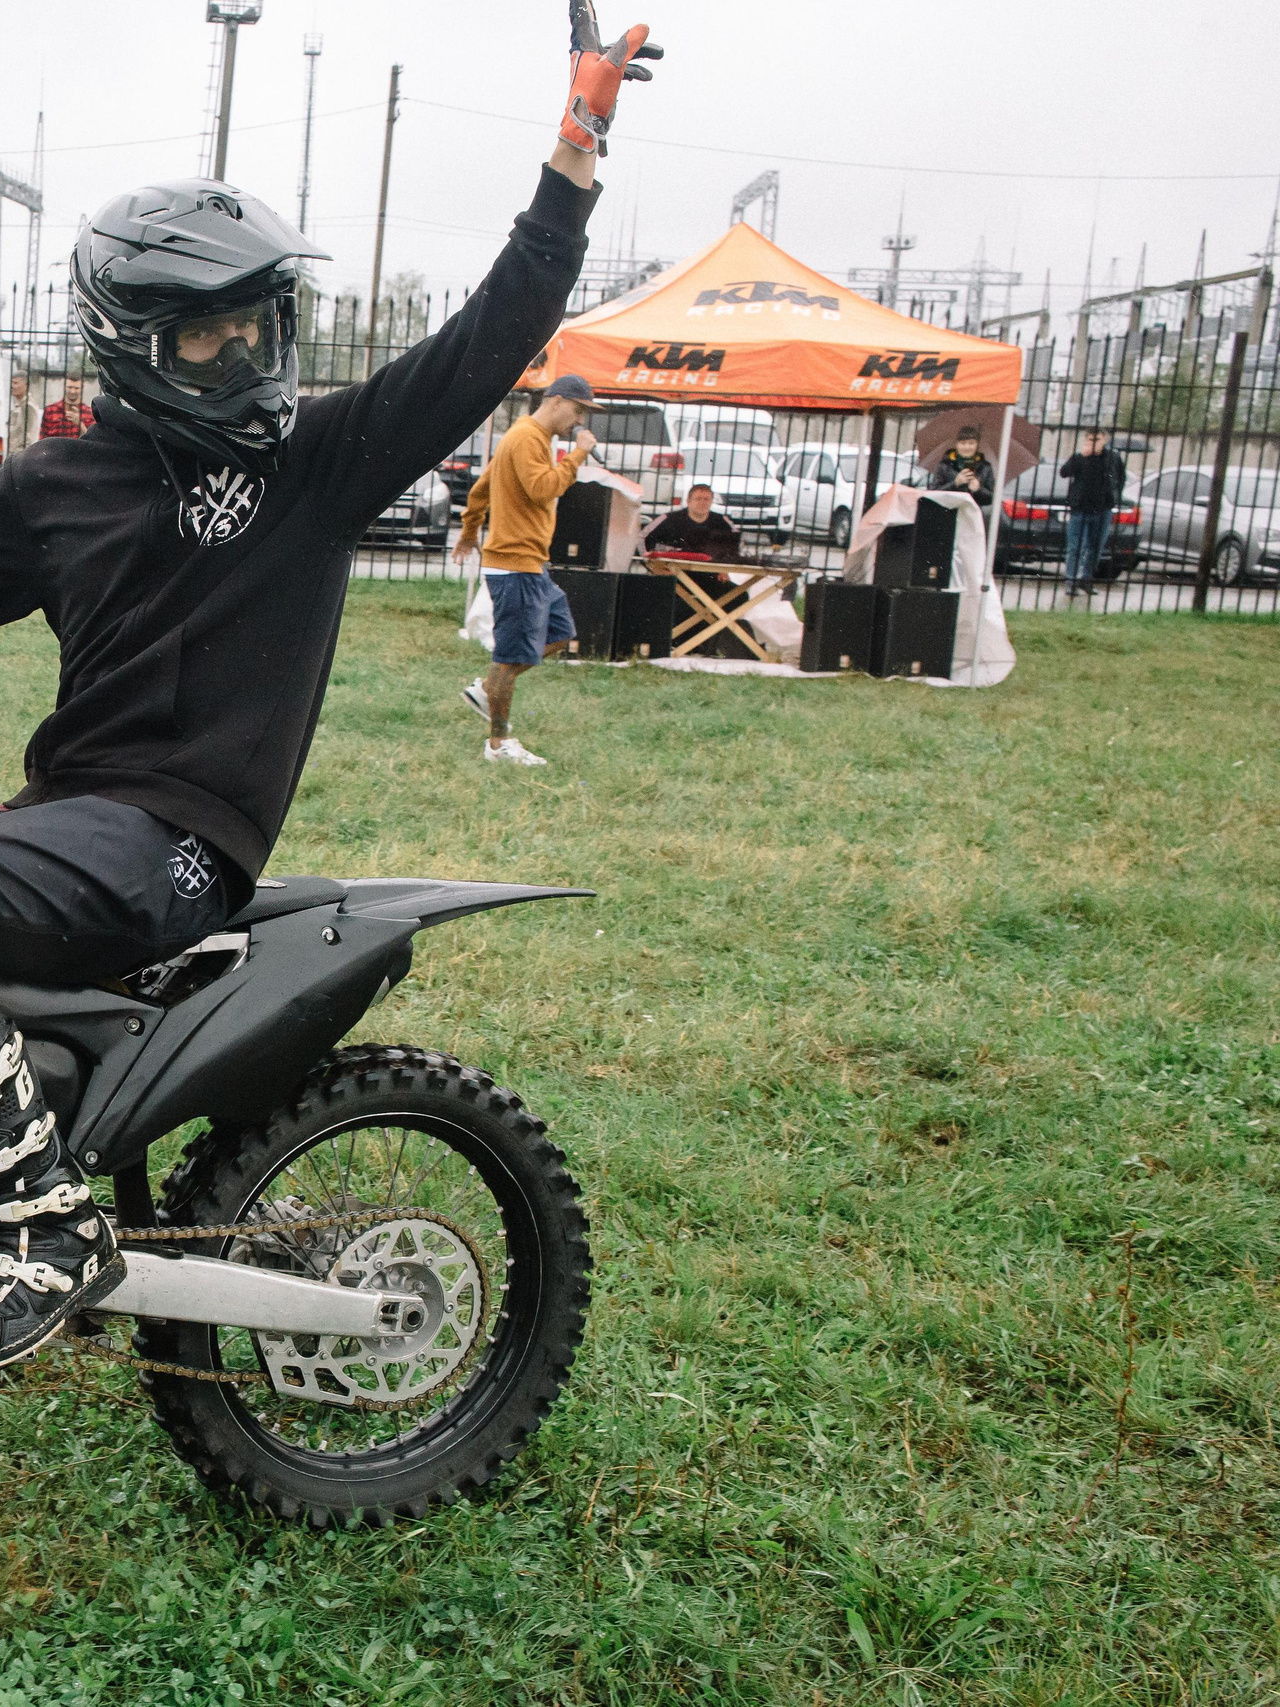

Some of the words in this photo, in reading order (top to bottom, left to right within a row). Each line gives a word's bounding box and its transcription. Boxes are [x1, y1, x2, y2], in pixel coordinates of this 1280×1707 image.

[693, 280, 840, 311] KTM
[150, 334, 158, 368] OAKLEY
[624, 340, 726, 371] KTM
[857, 349, 961, 381] KTM
